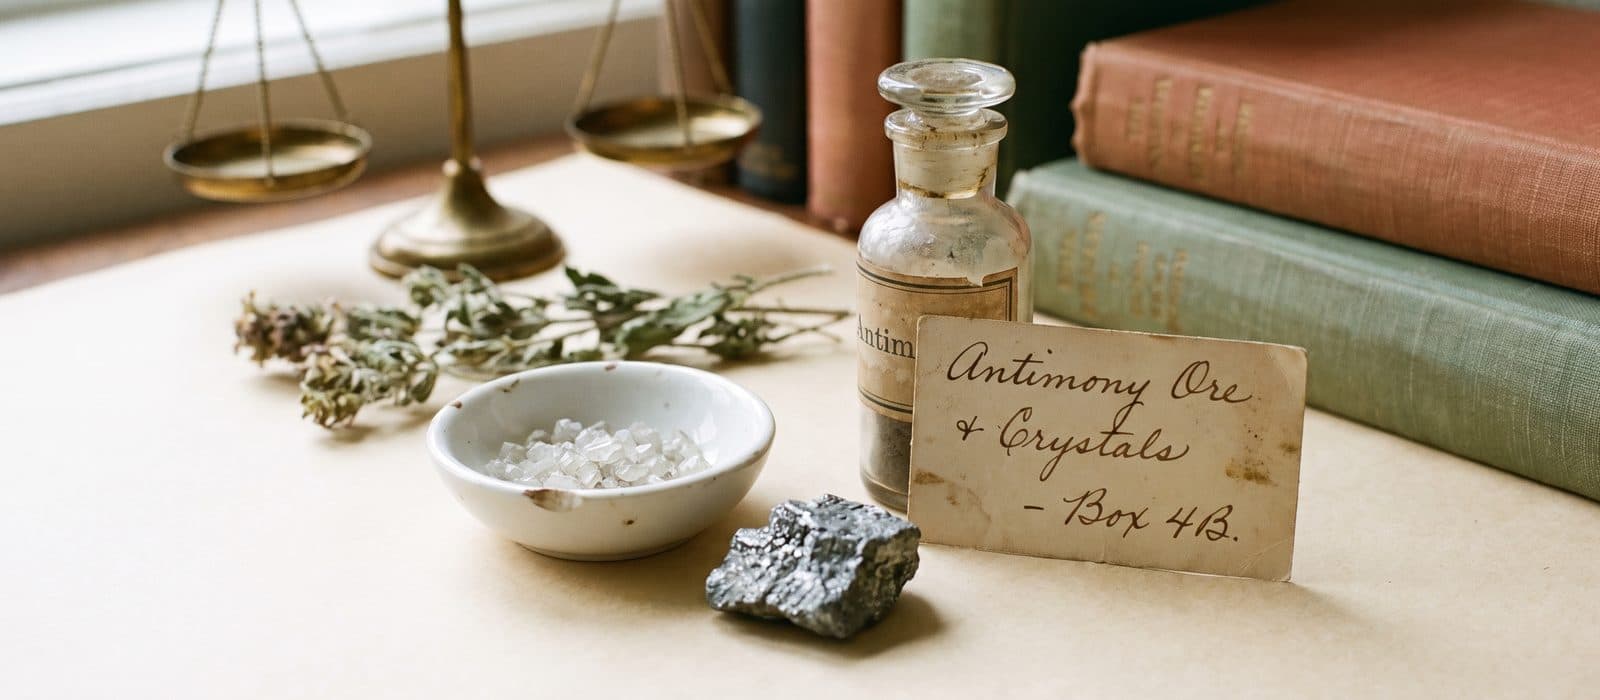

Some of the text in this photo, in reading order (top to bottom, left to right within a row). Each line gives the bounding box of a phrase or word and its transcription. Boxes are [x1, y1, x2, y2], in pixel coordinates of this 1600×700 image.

[946, 341, 1253, 433] Antimony Ore
[998, 406, 1190, 482] Crystals
[1063, 487, 1150, 539] Box
[1166, 504, 1239, 542] 4B.
